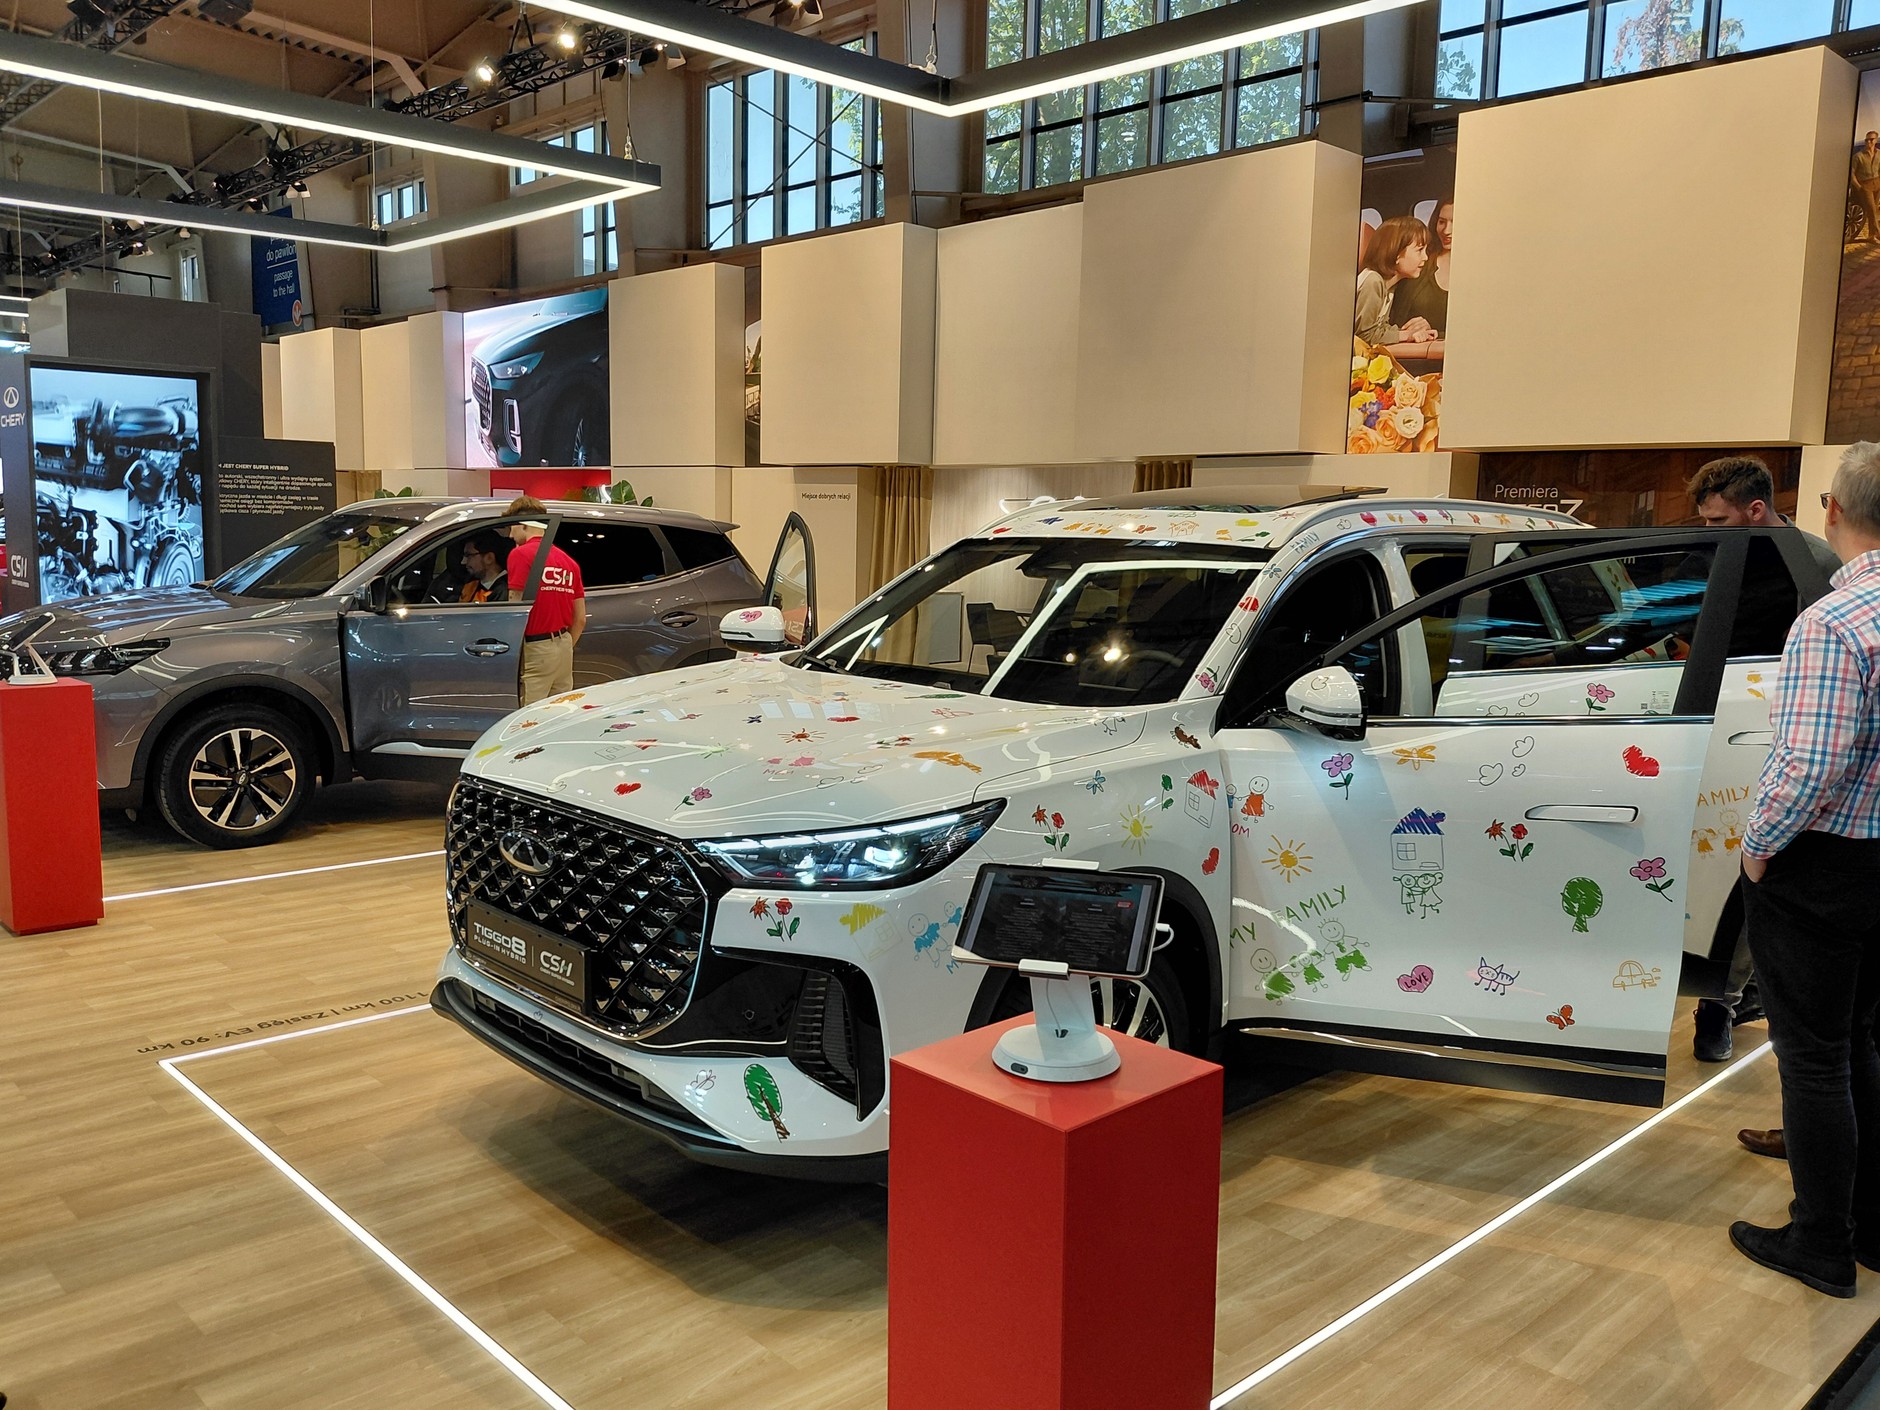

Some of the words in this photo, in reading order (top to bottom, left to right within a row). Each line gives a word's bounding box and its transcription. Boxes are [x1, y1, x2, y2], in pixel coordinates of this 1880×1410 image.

[267, 250, 274, 261] do
[275, 244, 297, 262] pawilon
[274, 270, 293, 285] passage
[273, 288, 277, 297] to
[1, 412, 25, 428] CHERY
[1495, 485, 1559, 498] Premiera
[11, 554, 28, 579] CSH
[542, 566, 573, 586] CSH
[1698, 786, 1749, 807] AMILY
[1232, 824, 1250, 838] OM
[474, 922, 526, 957] TIGGO8
[474, 934, 500, 952] PLUG-IN
[501, 947, 526, 964] HYBRID
[540, 951, 572, 977] CSH
[1404, 972, 1429, 989] LOVE
[342, 1001, 376, 1013] km
[257, 1012, 329, 1029] Zasięg
[214, 1027, 254, 1038] EV:
[137, 1043, 175, 1054] km
[180, 1036, 210, 1046] 90
